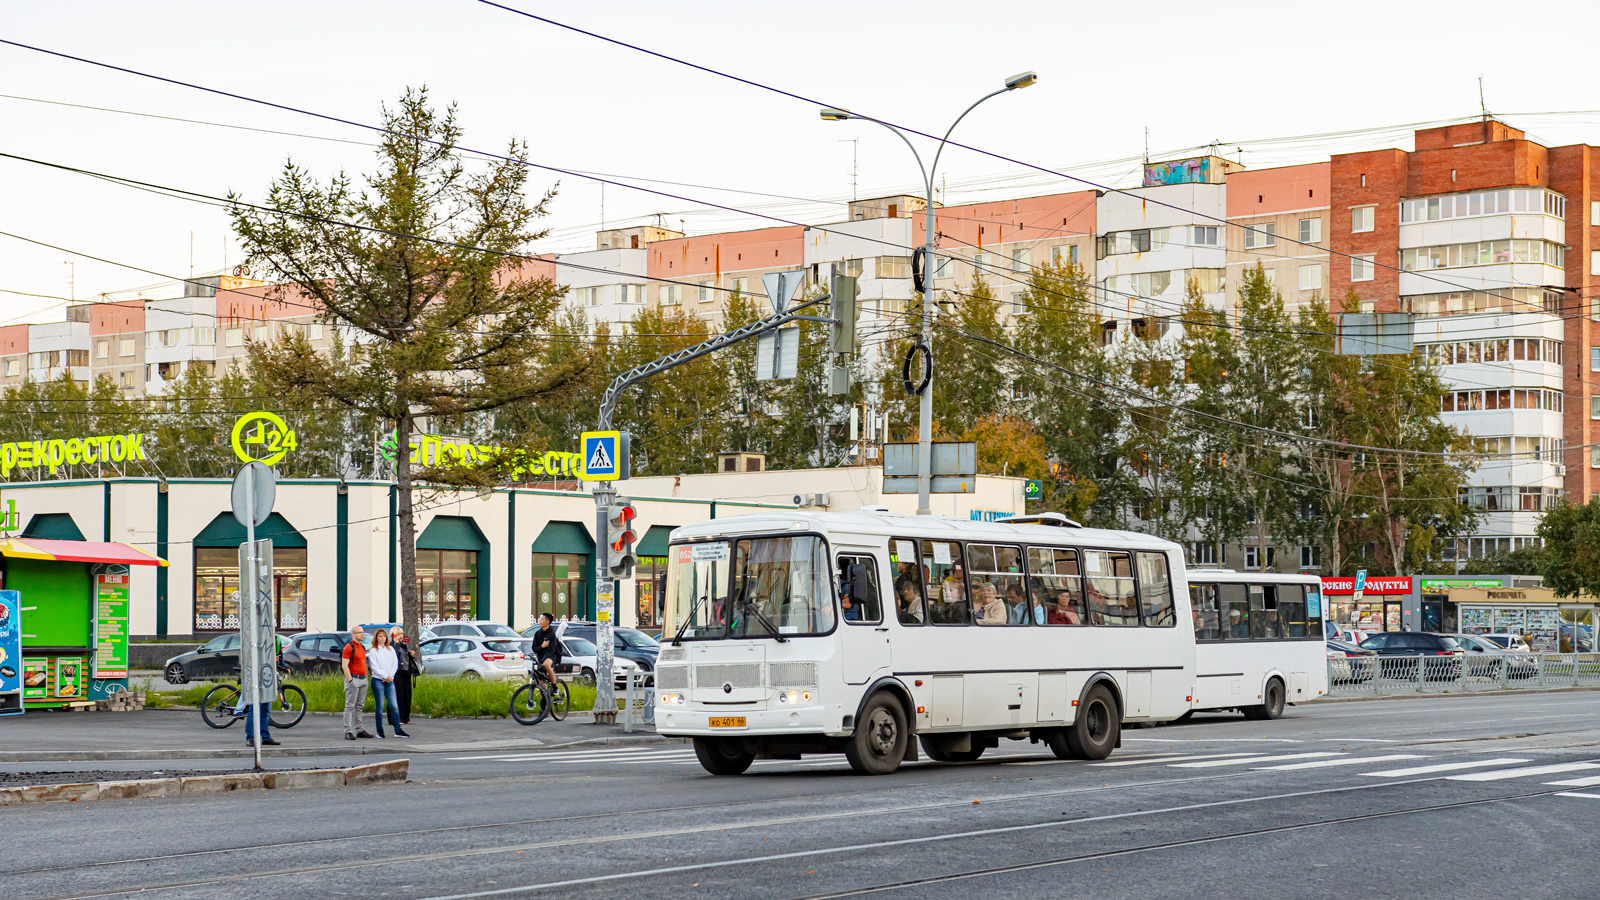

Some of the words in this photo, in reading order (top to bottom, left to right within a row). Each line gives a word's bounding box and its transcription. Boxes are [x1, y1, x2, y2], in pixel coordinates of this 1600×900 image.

[267, 430, 298, 451] 24
[680, 550, 691, 559] 052
[723, 718, 735, 726] 401
